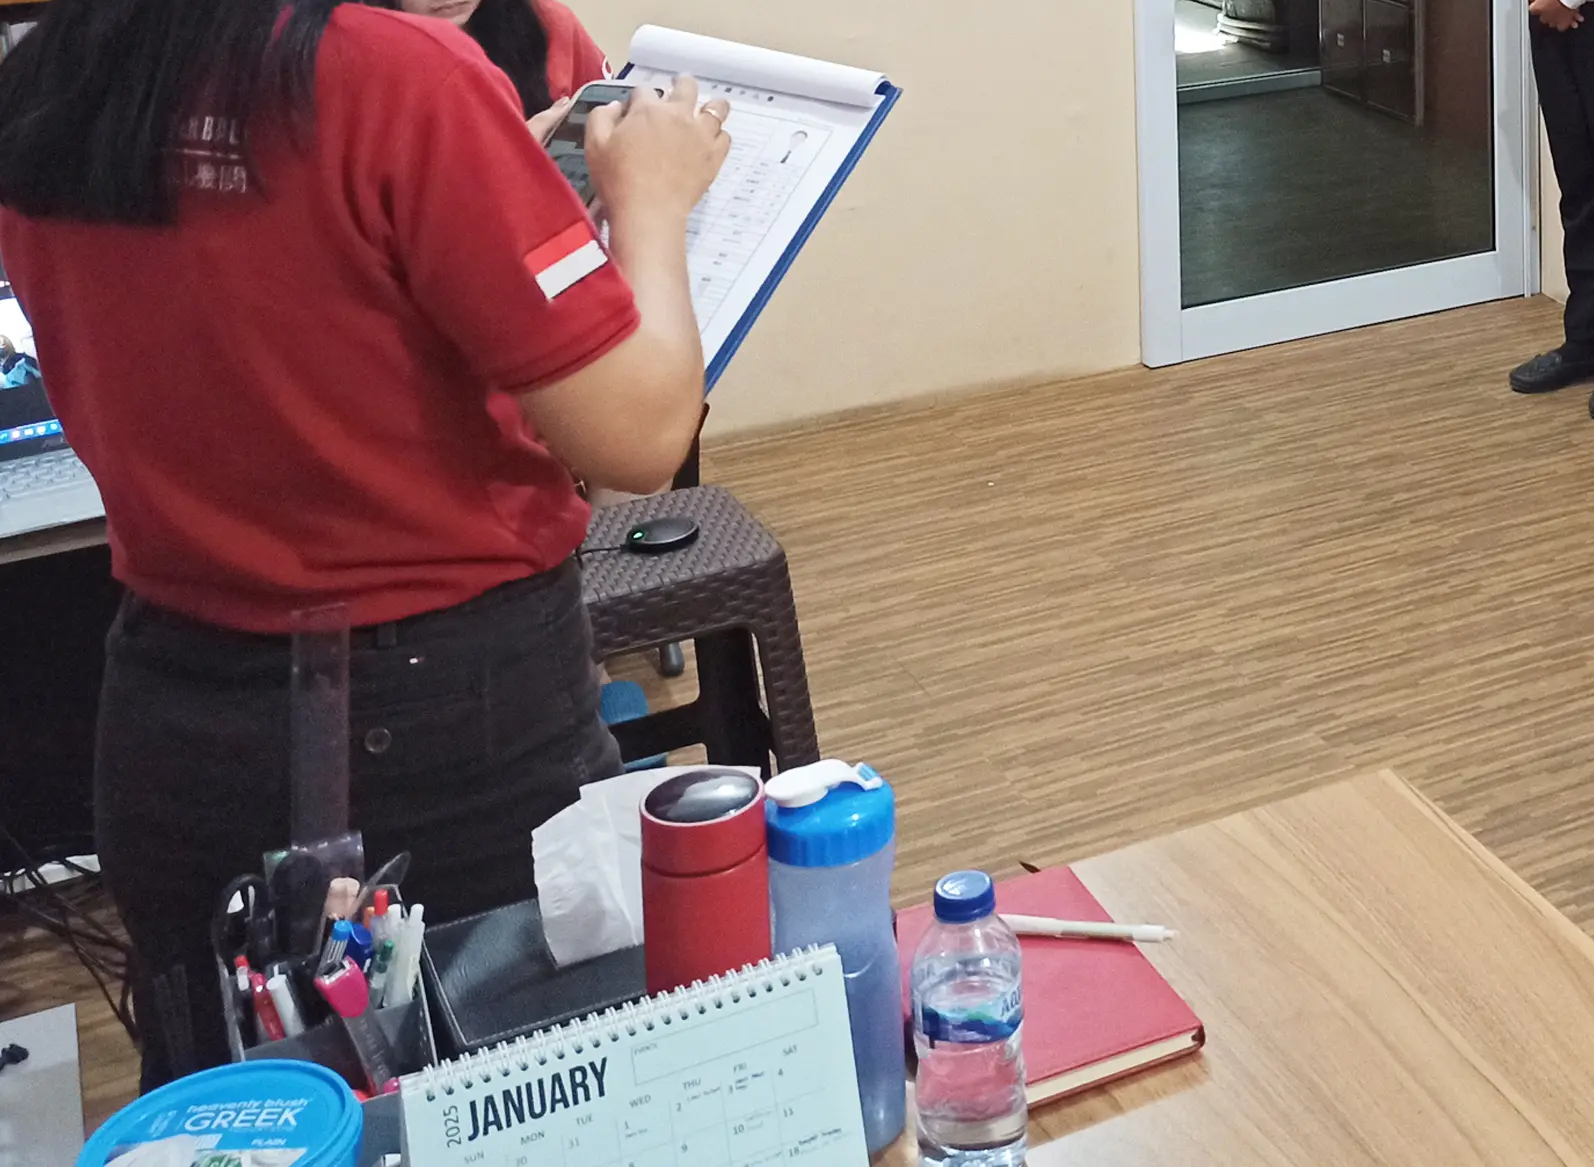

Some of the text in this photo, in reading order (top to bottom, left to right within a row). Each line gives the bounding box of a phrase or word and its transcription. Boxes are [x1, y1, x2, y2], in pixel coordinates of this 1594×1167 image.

[184, 1107, 305, 1132] GREEK
[264, 1097, 309, 1108] blush
[442, 1056, 608, 1149] 2025 JANUARY
[463, 1151, 486, 1165] SUN
[520, 1131, 546, 1147] MON
[575, 1114, 595, 1127] TUE
[629, 1094, 652, 1109] WED
[682, 1078, 703, 1091] THU
